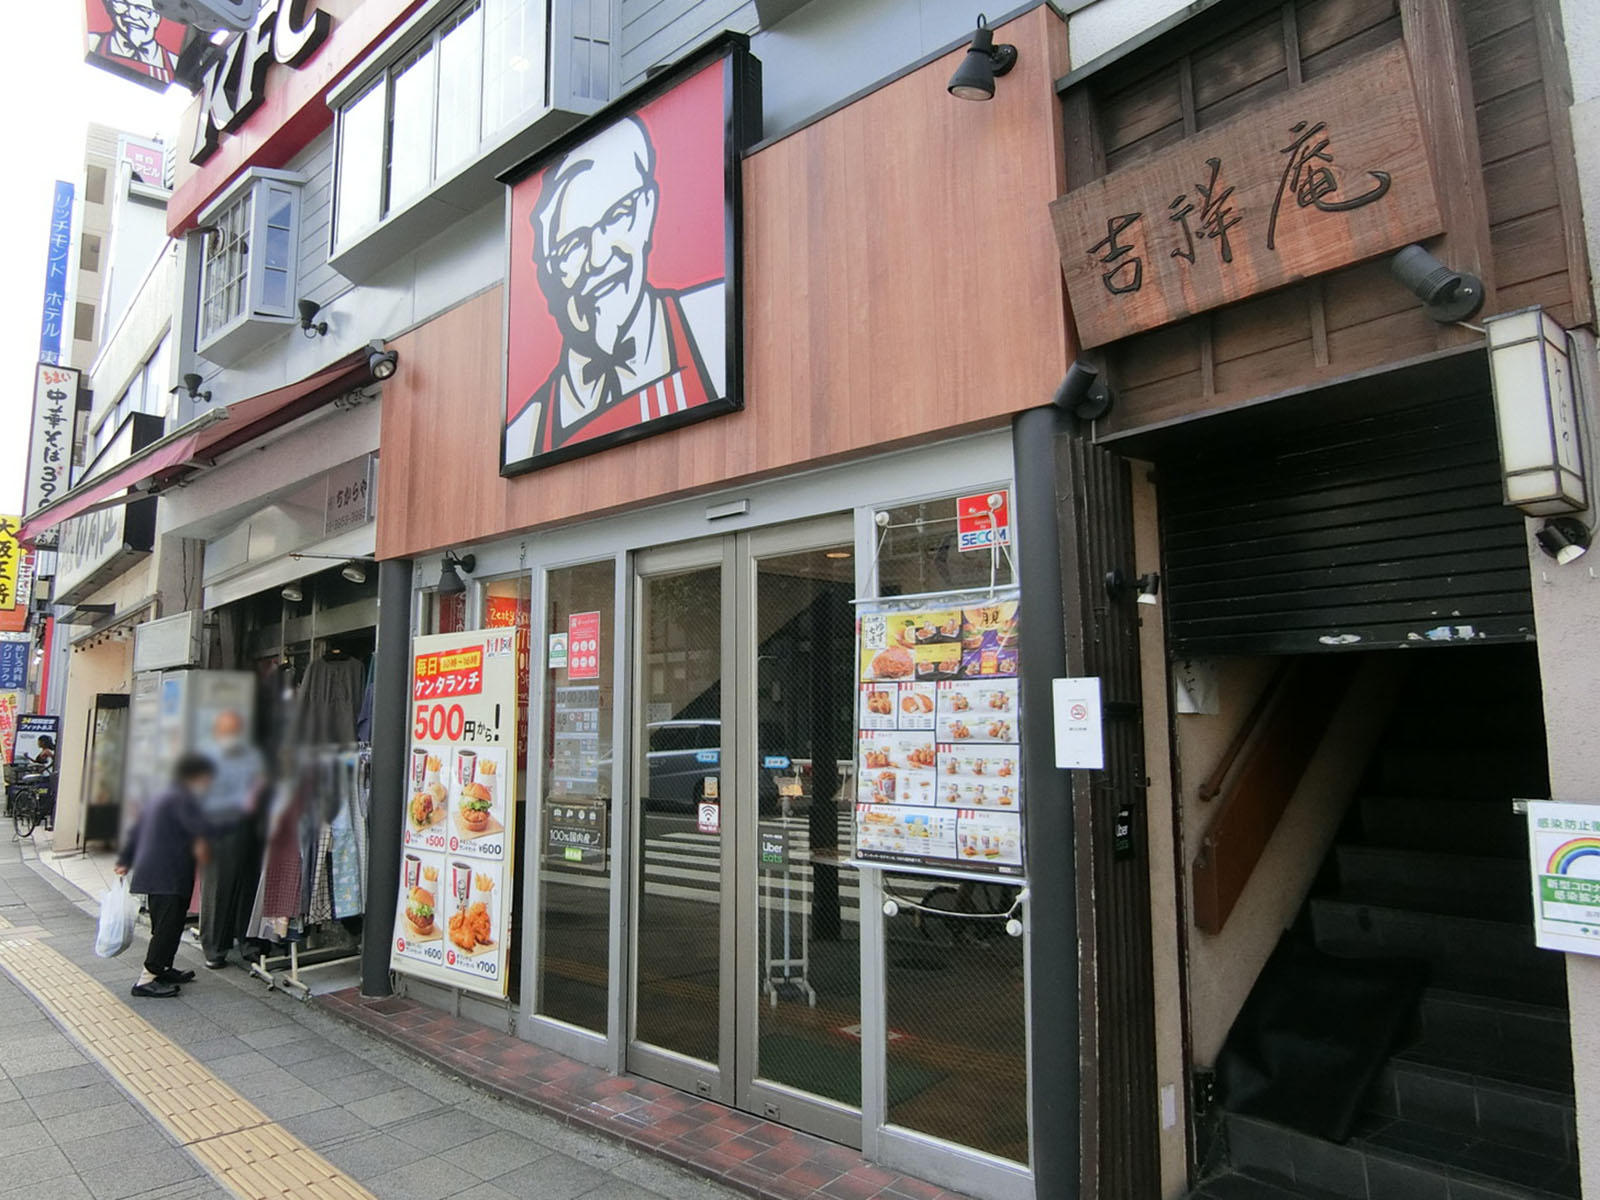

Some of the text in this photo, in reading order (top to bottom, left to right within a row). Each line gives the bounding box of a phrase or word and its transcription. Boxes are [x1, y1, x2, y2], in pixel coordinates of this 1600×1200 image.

[1087, 121, 1392, 295] 吉祥庵
[50, 194, 70, 277] リッチモンド
[43, 292, 62, 337] ホテル
[416, 657, 437, 676] 毎日
[415, 671, 480, 696] ケンタランチ
[762, 841, 783, 853] Uber
[762, 852, 783, 863] Eats
[476, 961, 496, 974] ¥700
